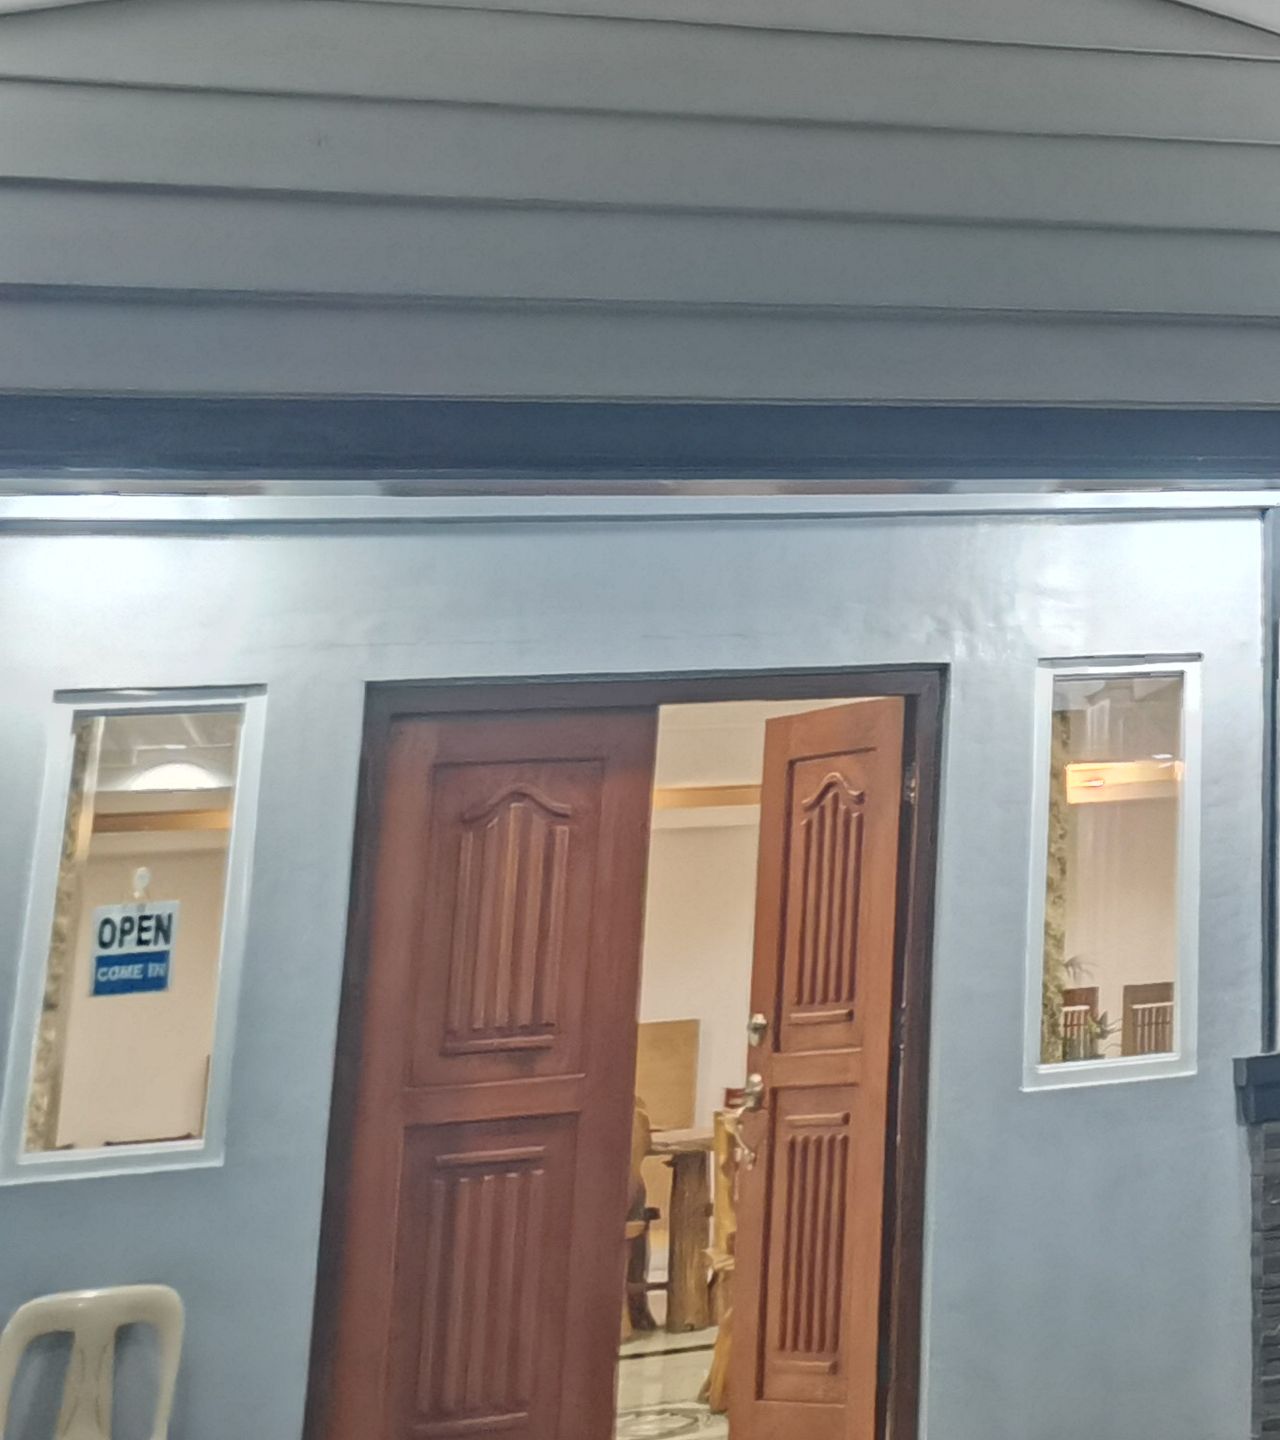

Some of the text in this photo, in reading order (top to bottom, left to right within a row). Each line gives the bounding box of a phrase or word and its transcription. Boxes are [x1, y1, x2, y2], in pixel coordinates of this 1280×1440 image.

[98, 913, 172, 949] OPEN
[97, 961, 167, 982] COME IN
